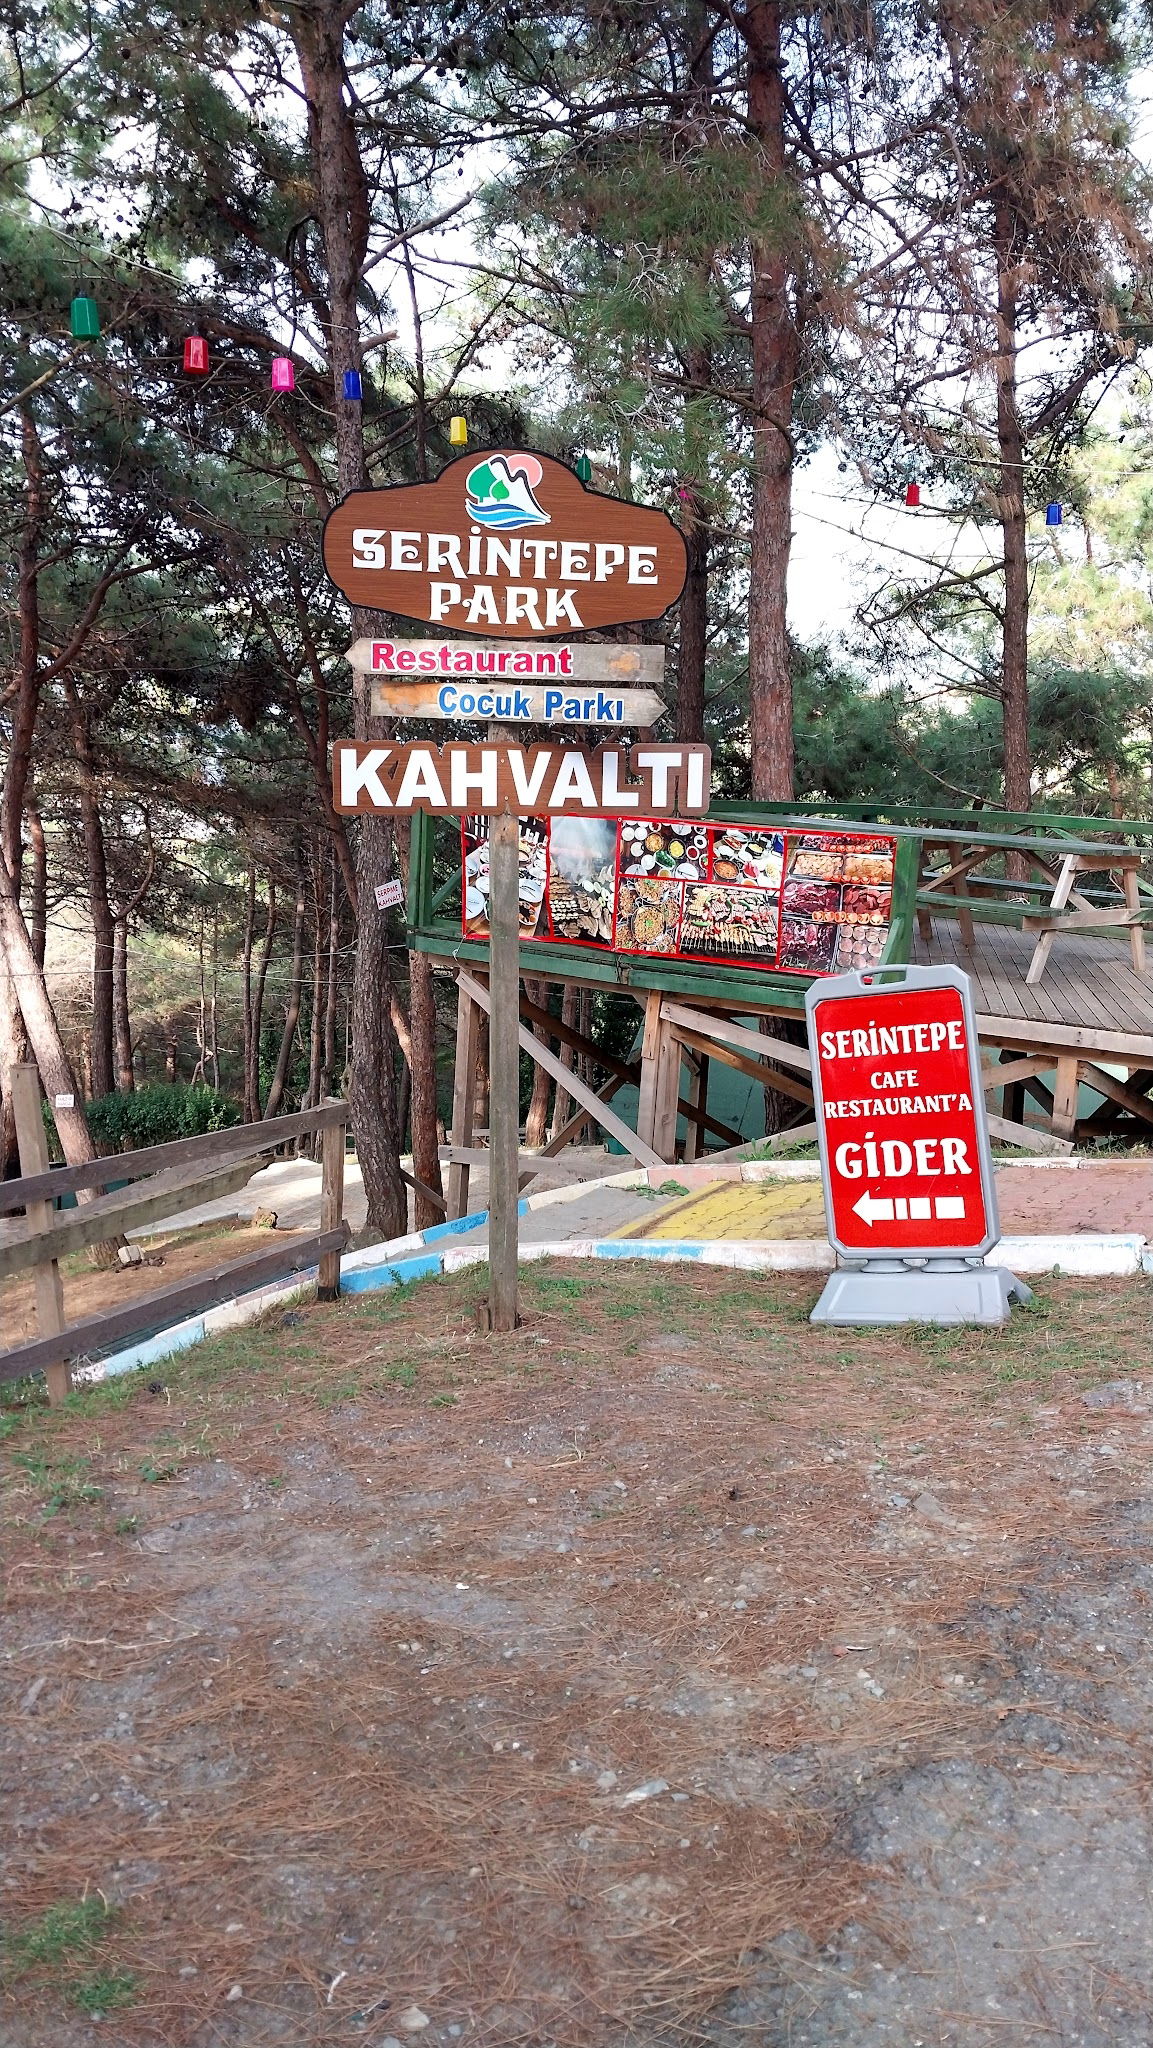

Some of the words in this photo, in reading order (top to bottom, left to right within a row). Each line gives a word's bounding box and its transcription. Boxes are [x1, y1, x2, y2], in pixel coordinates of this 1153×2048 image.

[352, 525, 659, 585] SERİNTEPE
[429, 581, 585, 631] PARK
[371, 642, 574, 676] Restaurant
[438, 686, 532, 718] Çocuk
[545, 690, 625, 722] Parkı
[340, 748, 704, 808] KAHVALTI
[821, 1020, 965, 1060] SERİNTEPE
[870, 1069, 919, 1090] CAFE
[824, 1094, 973, 1119] RESTAURANT'A
[835, 1132, 973, 1179] GİDER
